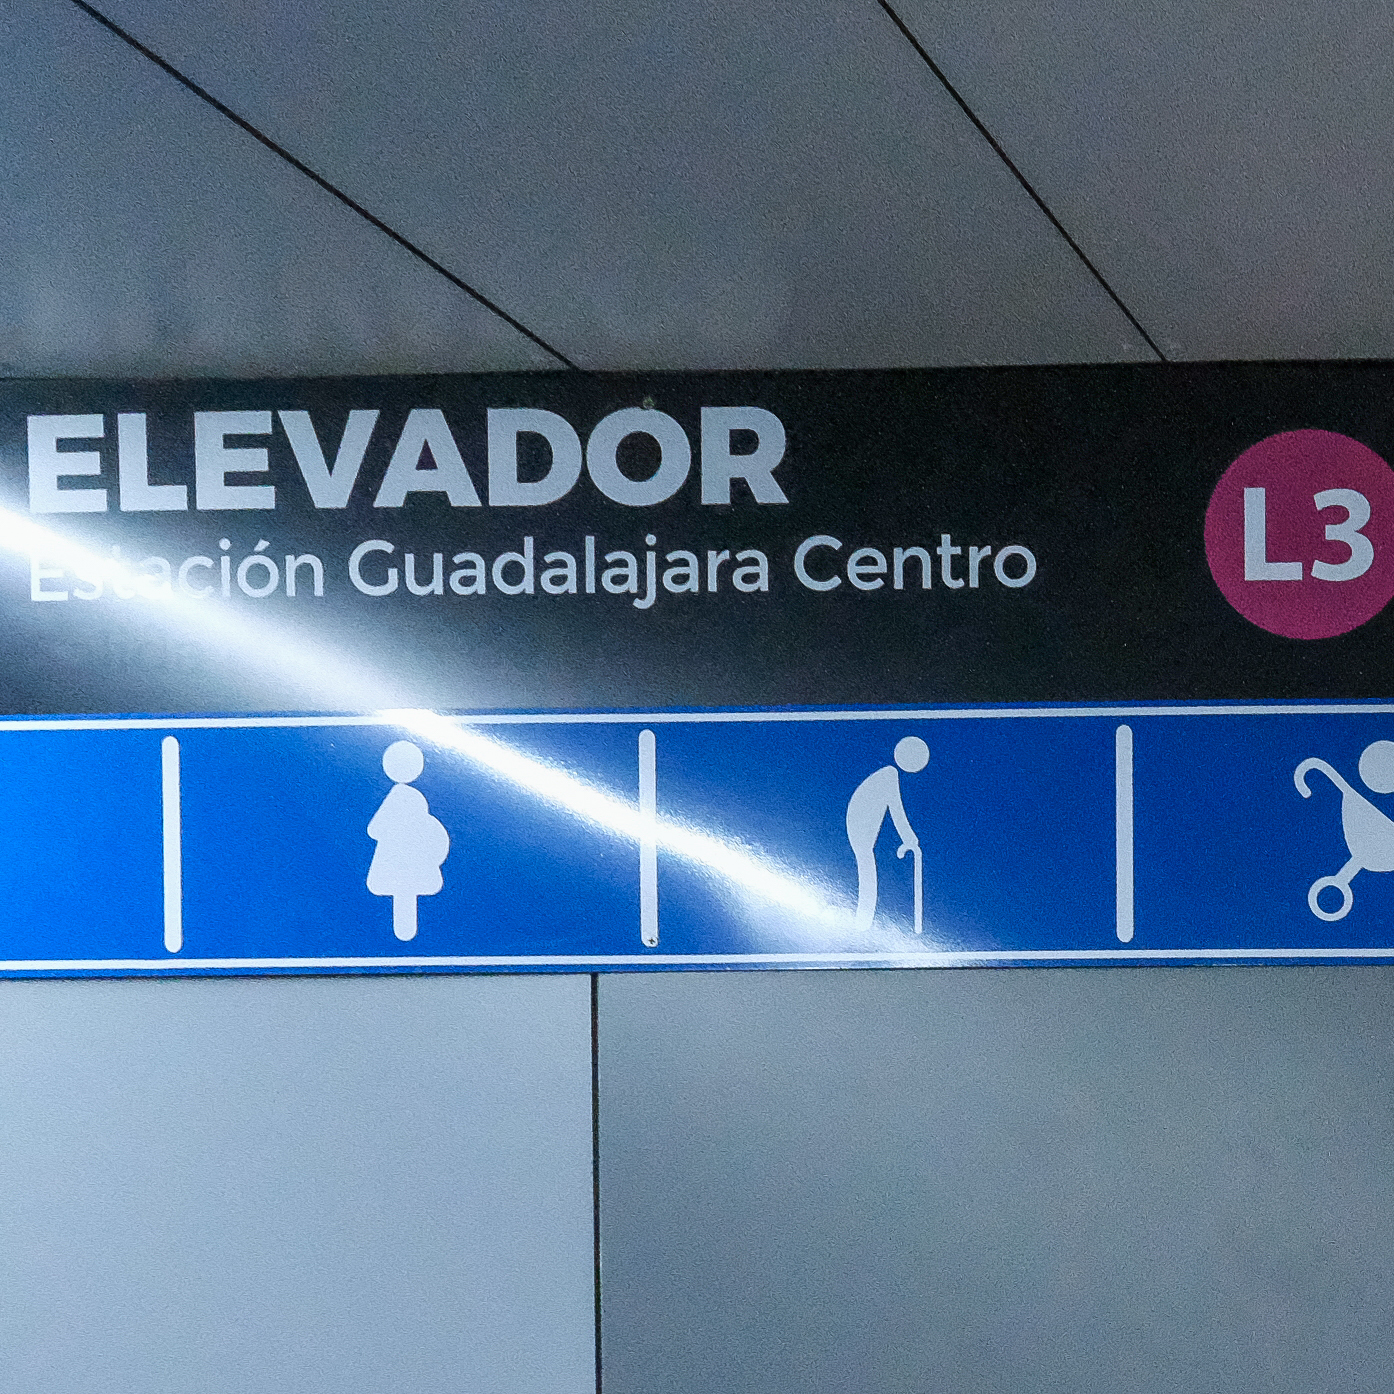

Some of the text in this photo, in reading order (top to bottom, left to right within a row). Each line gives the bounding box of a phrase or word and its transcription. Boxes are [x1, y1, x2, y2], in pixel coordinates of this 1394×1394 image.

[26, 408, 789, 514] ELEVADOR
[30, 533, 1038, 609] Estación Guadalajara Centro
[1242, 486, 1375, 582] L3
